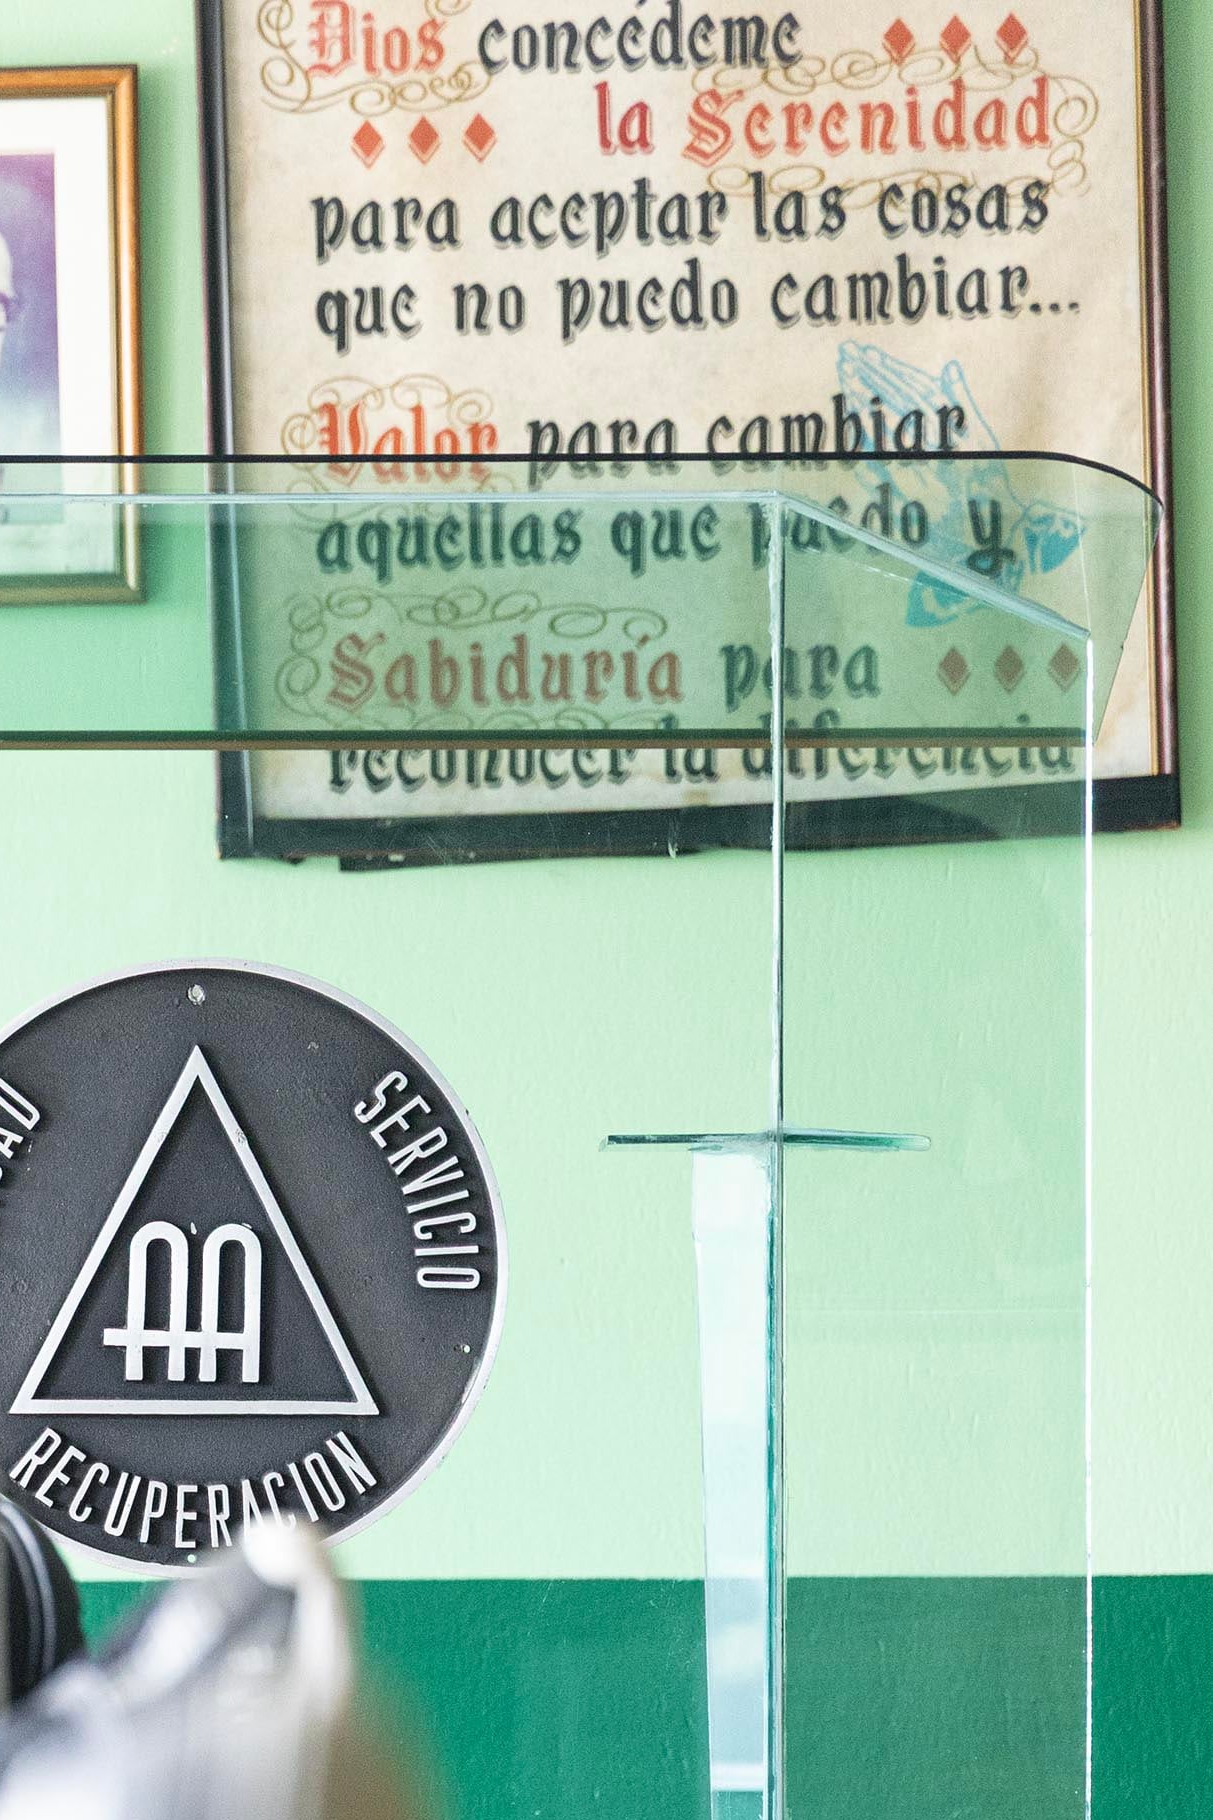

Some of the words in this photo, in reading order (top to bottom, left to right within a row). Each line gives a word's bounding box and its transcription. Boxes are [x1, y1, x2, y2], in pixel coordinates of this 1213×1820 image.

[307, 0, 448, 79] Dios
[477, 0, 803, 75] concédeme
[595, 80, 655, 155] la
[682, 74, 1051, 167] Serenidad
[310, 195, 463, 265] para
[489, 177, 728, 258] aceptar
[748, 171, 846, 243] las
[877, 179, 1050, 239] cosas
[315, 283, 423, 358] que
[453, 282, 525, 336] no
[557, 256, 739, 346] puedo
[770, 252, 1080, 329] cambiar...
[318, 401, 498, 486] Valor
[527, 417, 682, 490] para
[706, 393, 966, 476] cambiar
[316, 500, 583, 586] aquellas
[610, 503, 721, 578] que
[967, 494, 1017, 579] y
[325, 632, 684, 711] Sabiduría
[720, 642, 881, 712] para
[354, 1070, 481, 1290] SERVICIO
[103, 1221, 263, 1383] AA
[8, 1426, 378, 1549] RECUPERACION
